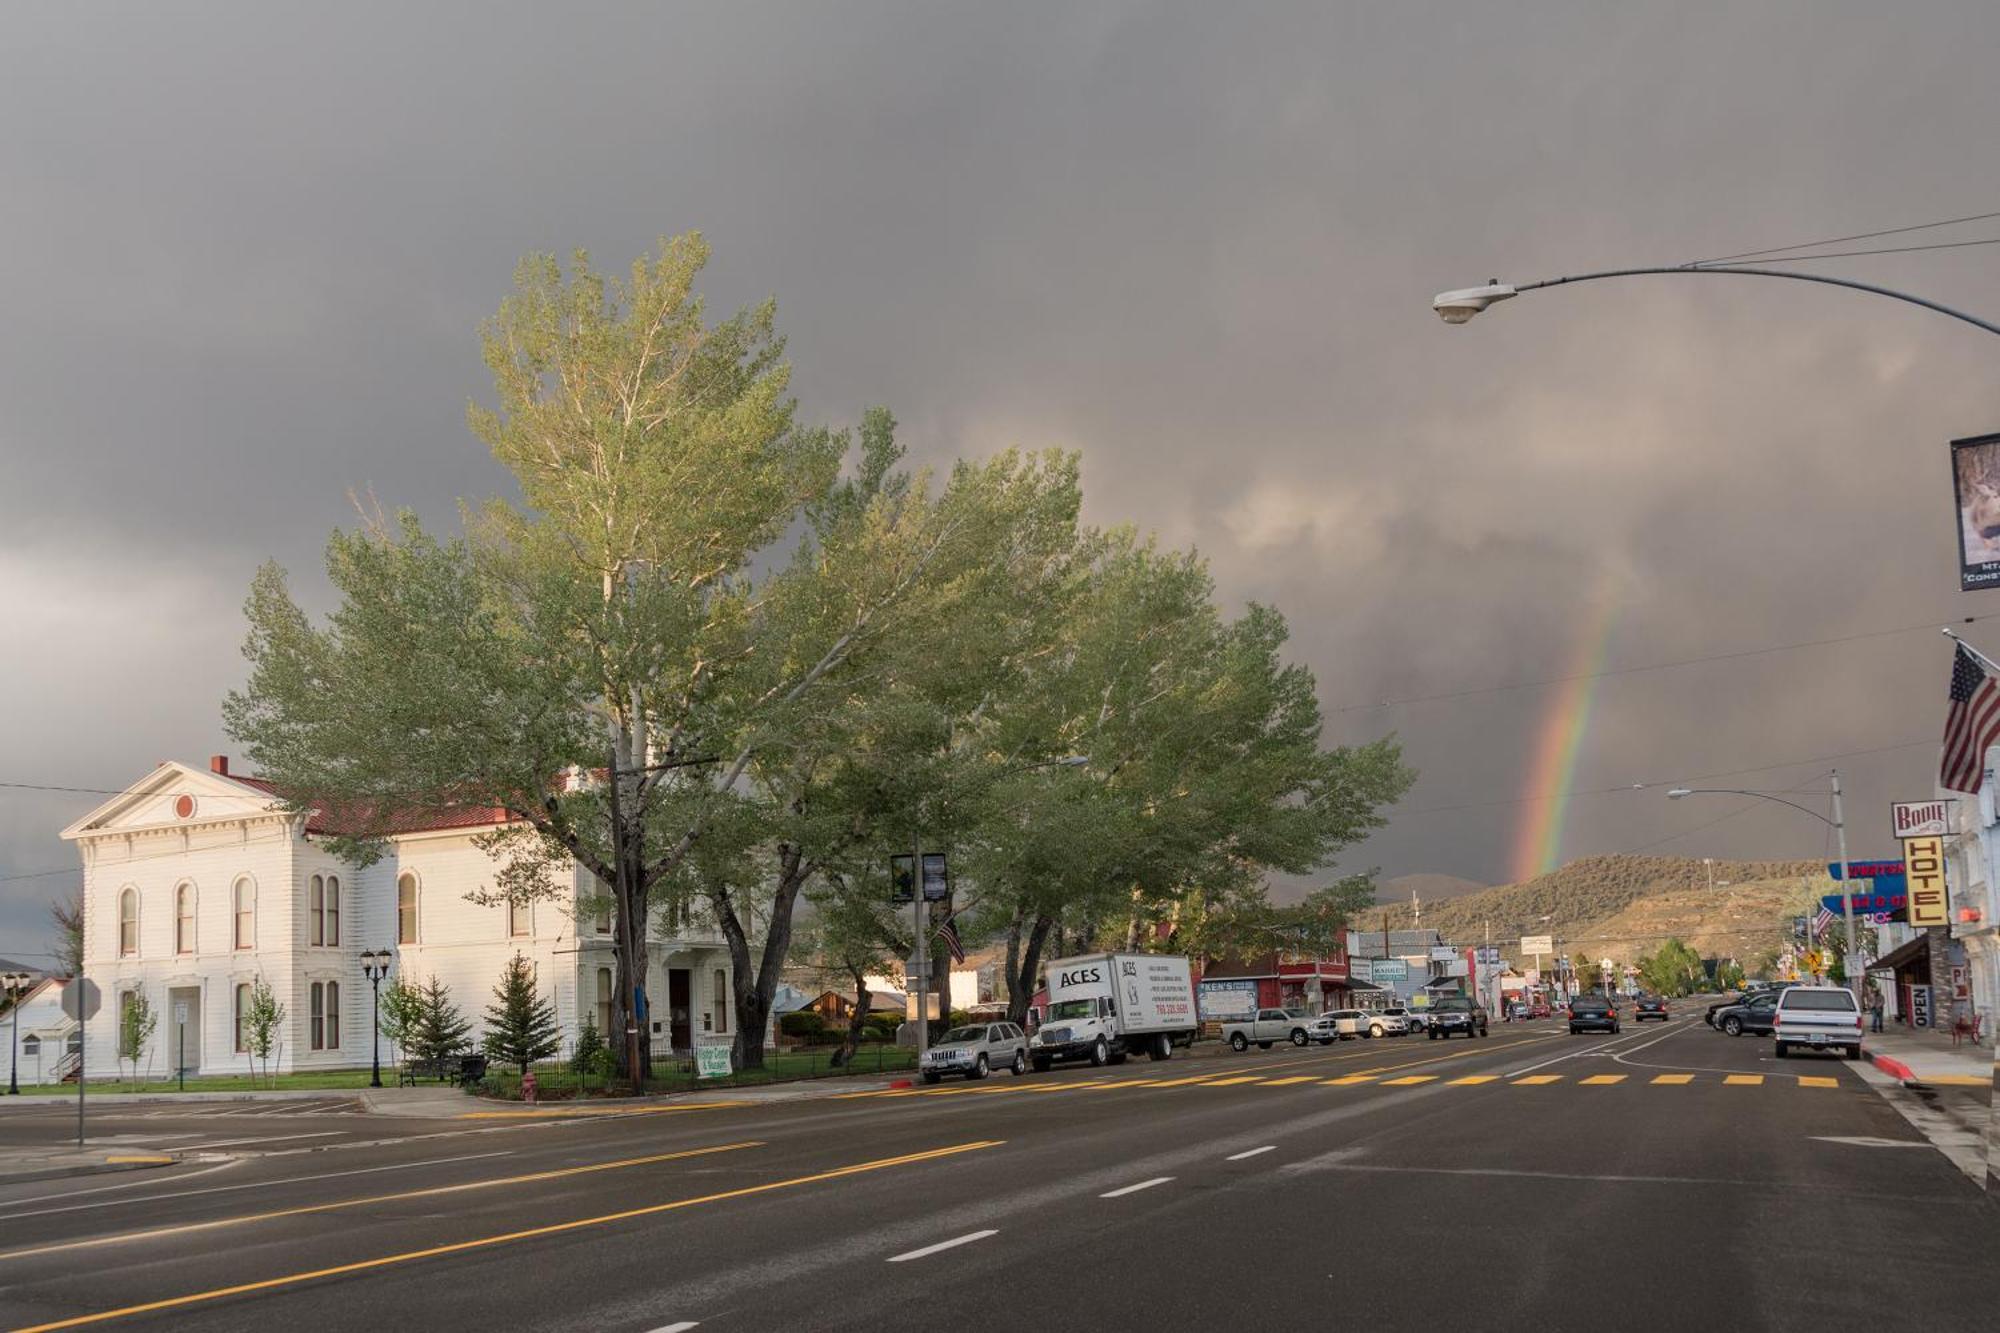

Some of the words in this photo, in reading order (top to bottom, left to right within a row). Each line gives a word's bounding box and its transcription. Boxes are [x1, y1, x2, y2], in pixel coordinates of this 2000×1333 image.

[1909, 841, 1943, 922] HOTEL
[1060, 968, 1101, 988] ACES
[1204, 981, 1233, 991] KEN'S
[1913, 988, 1927, 1026] OPEN
